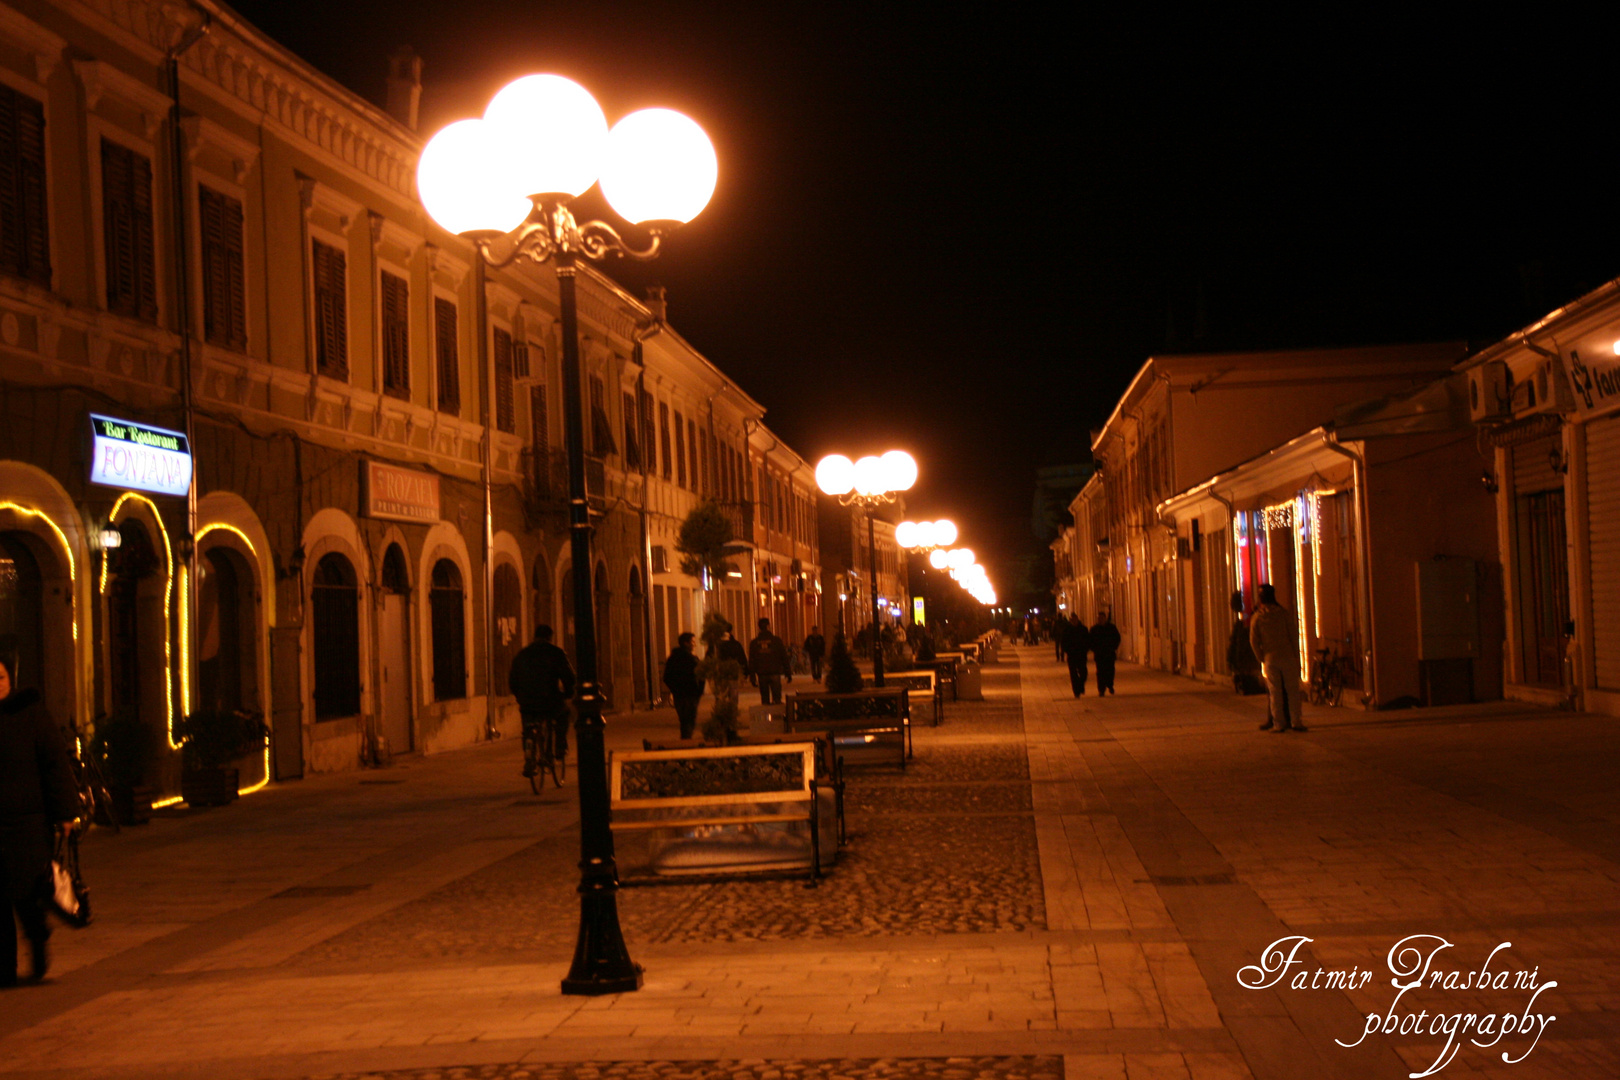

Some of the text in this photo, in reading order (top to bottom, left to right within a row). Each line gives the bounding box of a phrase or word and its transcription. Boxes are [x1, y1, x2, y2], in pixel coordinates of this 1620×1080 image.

[102, 420, 179, 451] Bar Restorant
[102, 445, 184, 489] FONTANA
